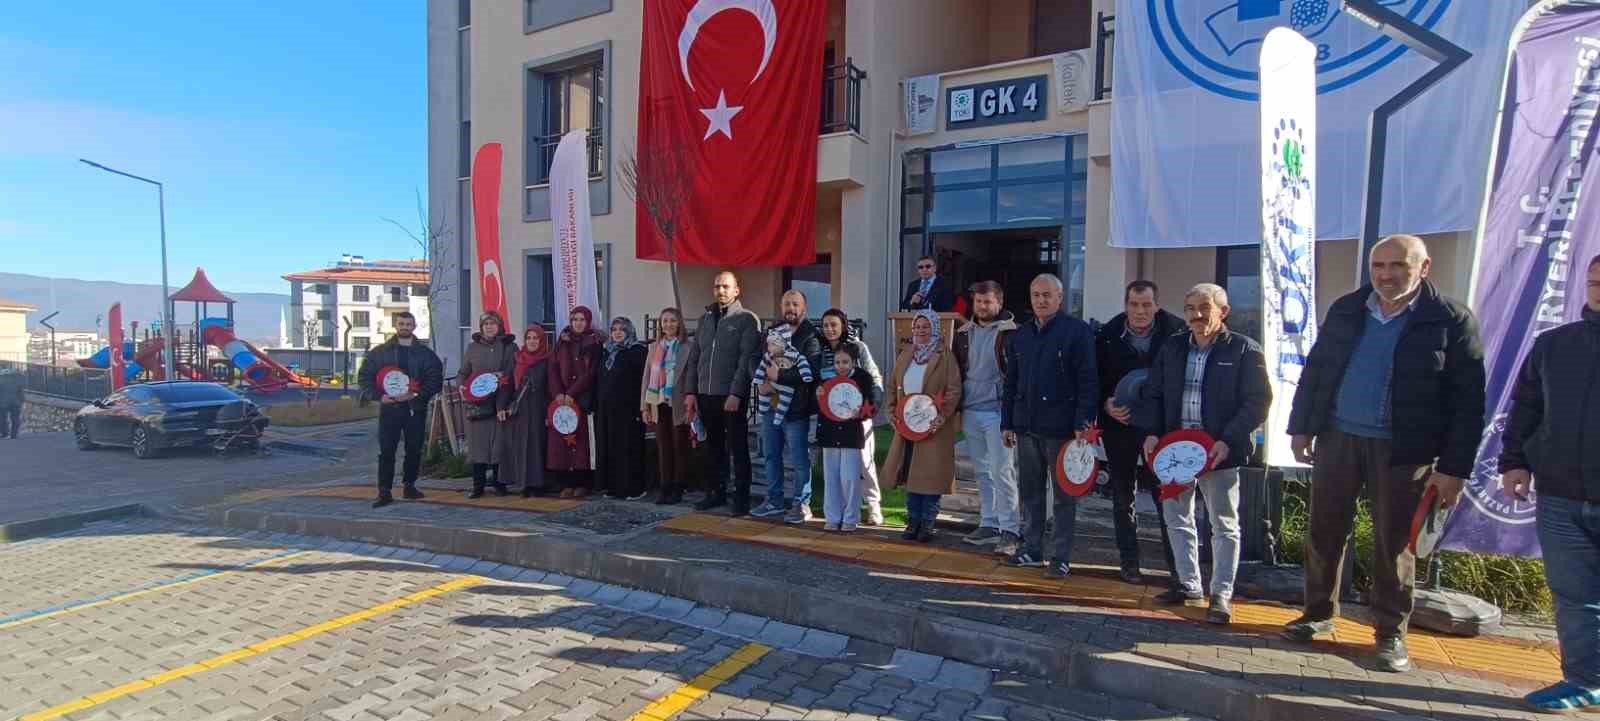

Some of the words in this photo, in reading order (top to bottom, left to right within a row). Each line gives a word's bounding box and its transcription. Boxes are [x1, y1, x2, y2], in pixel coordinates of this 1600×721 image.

[980, 85, 1016, 117] GK
[1022, 83, 1038, 111] 4
[1534, 222, 1574, 333] RYERİ
